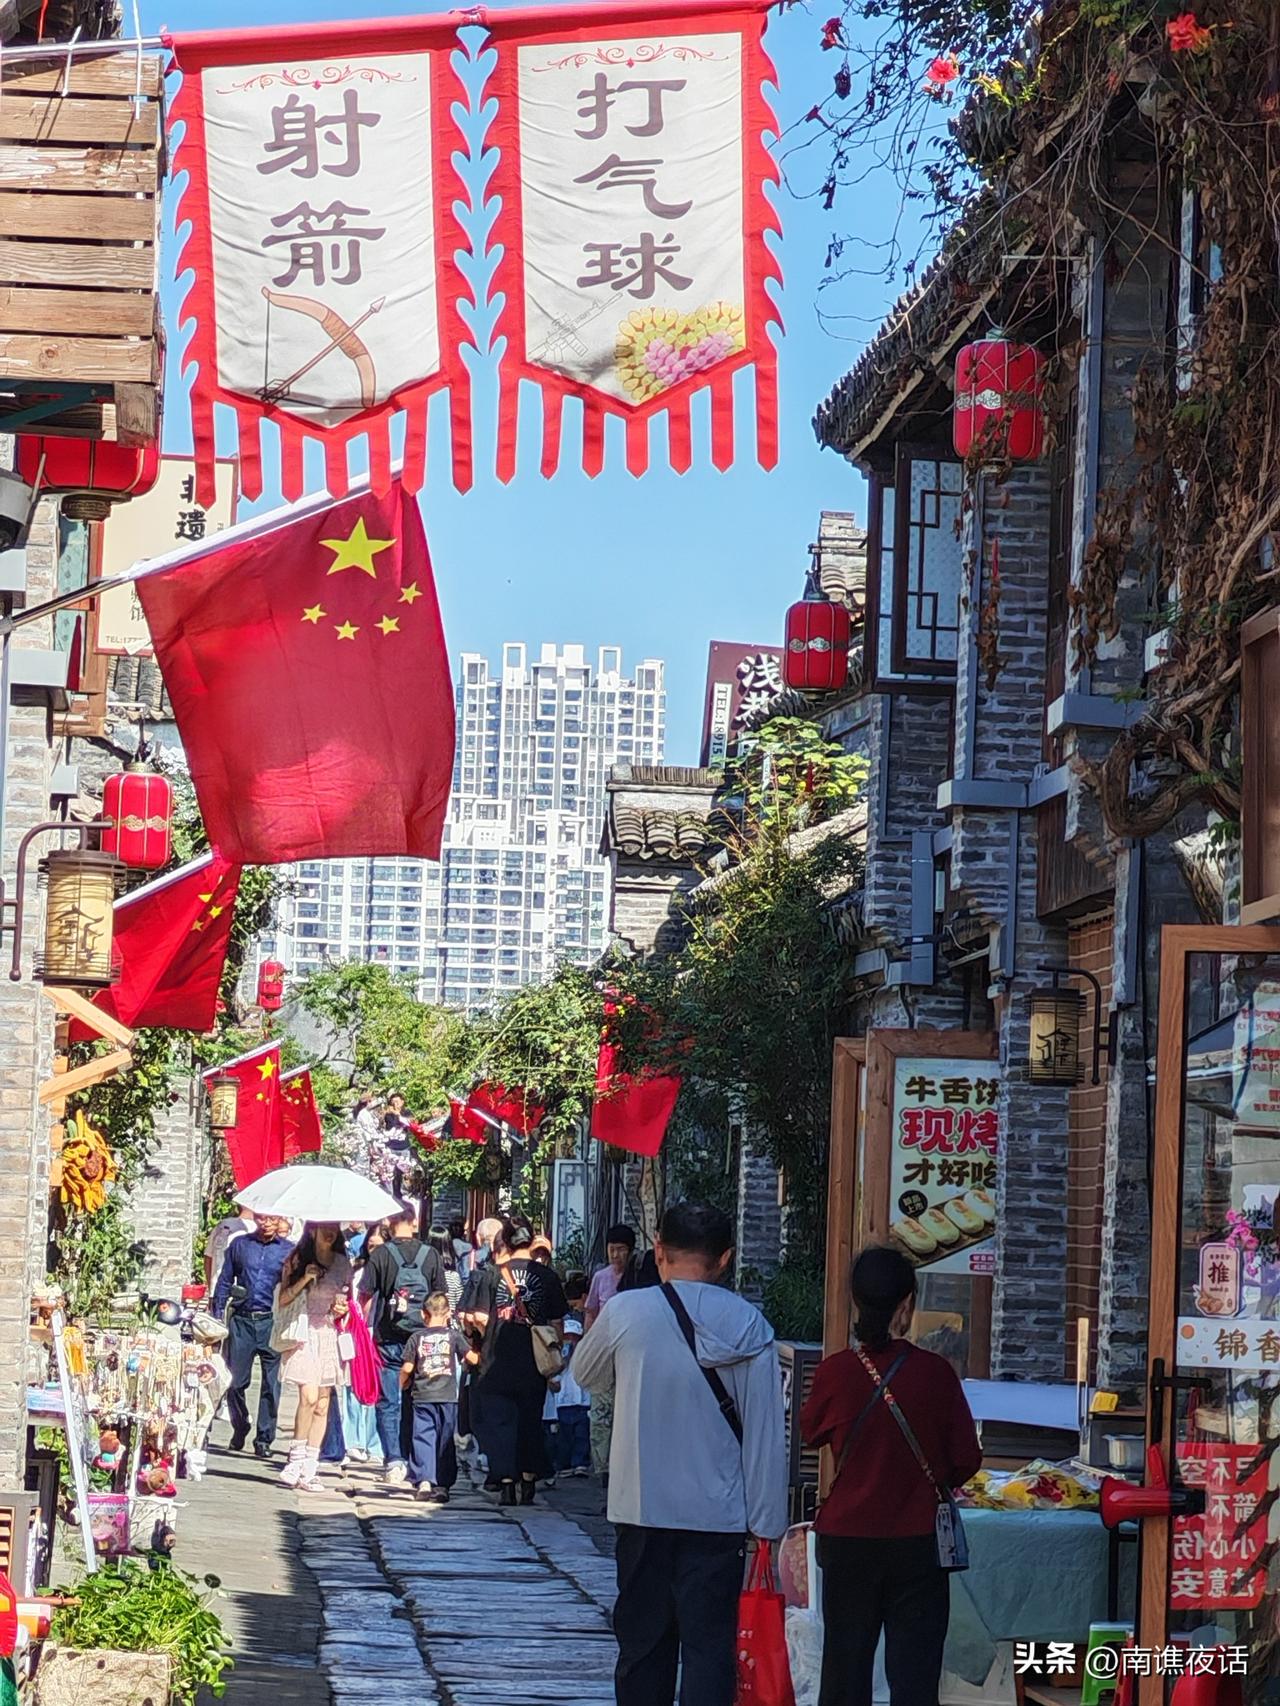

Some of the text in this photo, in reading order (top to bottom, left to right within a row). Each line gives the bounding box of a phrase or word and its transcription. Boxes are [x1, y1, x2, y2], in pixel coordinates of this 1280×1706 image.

[256, 88, 387, 287] 射箭
[573, 72, 694, 300] 打气球
[902, 1108, 999, 1154] 现烤
[903, 1158, 998, 1189] 才好吃
[1208, 1261, 1231, 1284] 推
[1213, 1327, 1280, 1364] 锦香
